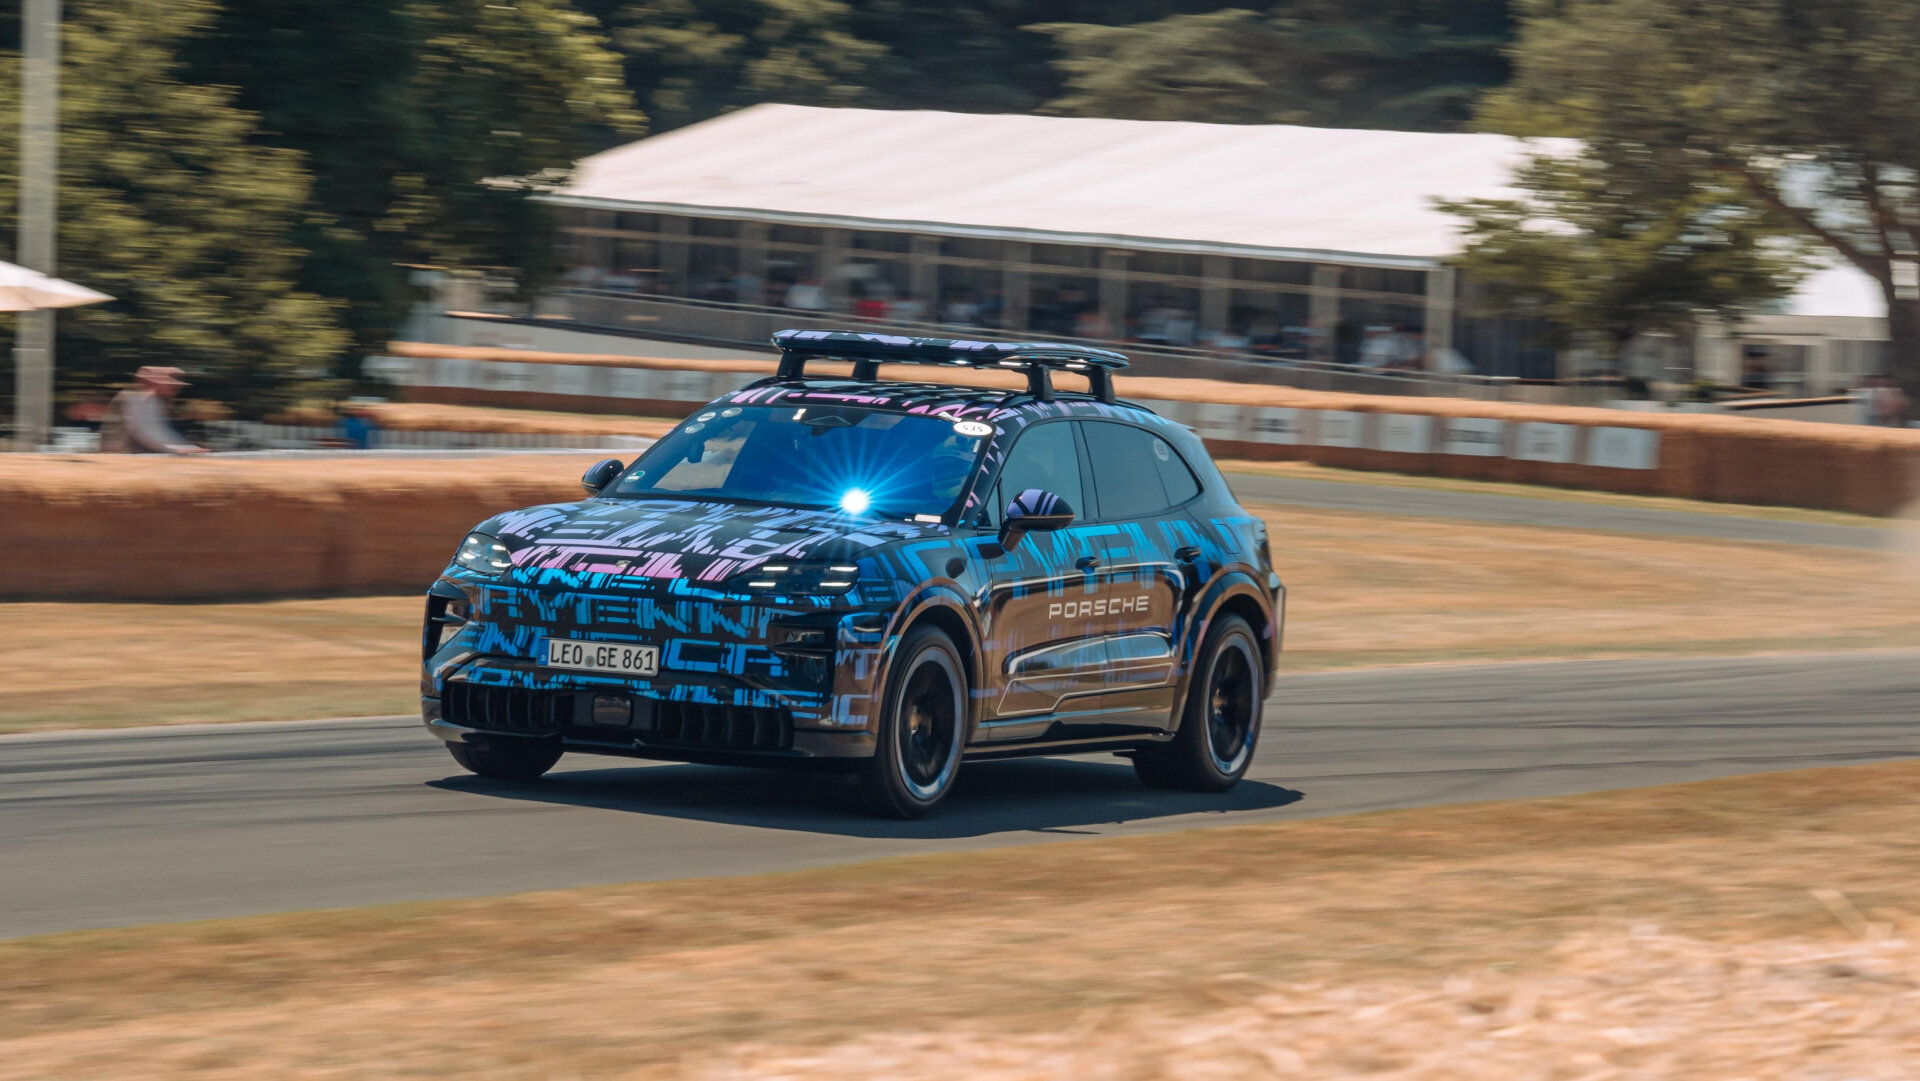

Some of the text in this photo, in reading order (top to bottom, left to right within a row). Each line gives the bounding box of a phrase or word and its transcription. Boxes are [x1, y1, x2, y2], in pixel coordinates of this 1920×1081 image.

[1049, 595, 1149, 619] PORSCHE
[550, 643, 583, 665] LEO
[596, 646, 618, 668] GE
[622, 648, 654, 671] 861
